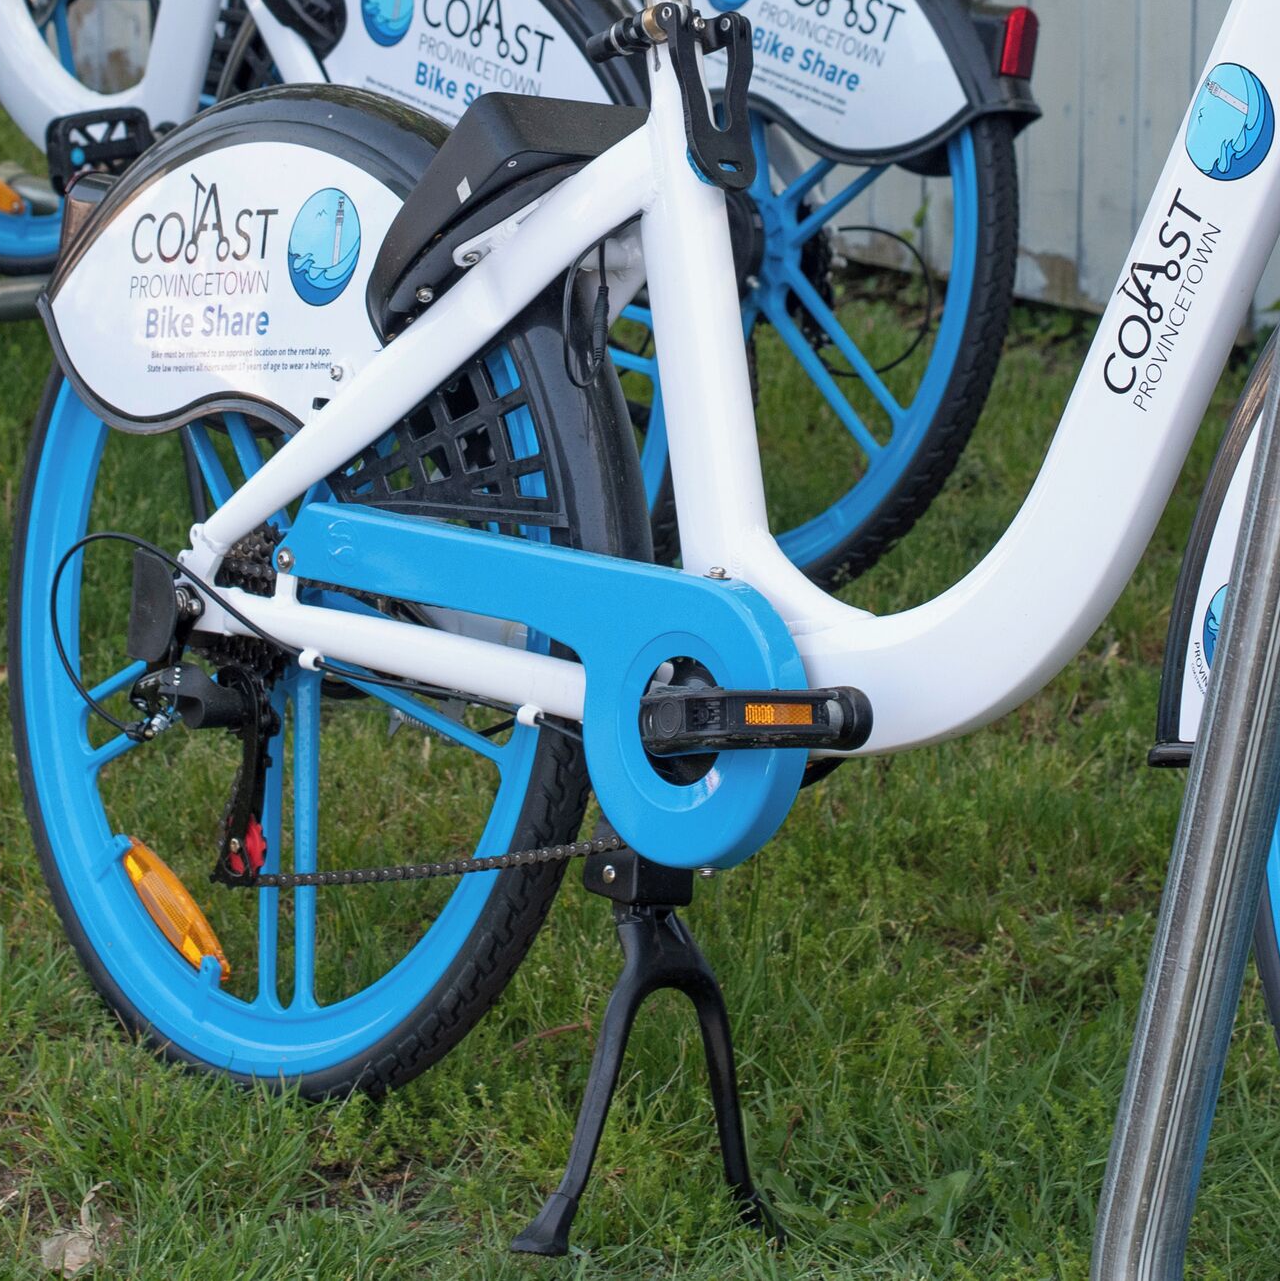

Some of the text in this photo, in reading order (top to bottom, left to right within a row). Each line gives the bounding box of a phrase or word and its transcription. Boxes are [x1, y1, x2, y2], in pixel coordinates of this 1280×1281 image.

[418, 33, 542, 96] PROVINCETOWN
[753, 27, 794, 64] Bike
[799, 48, 860, 92] Share
[758, 1, 886, 68] PROVINCETOWN
[415, 61, 457, 100] Bike
[131, 173, 279, 264] COAST
[129, 270, 270, 299] PROVINCETOWN
[1103, 187, 1203, 396] COAST
[145, 304, 270, 340] Bike Share
[1132, 221, 1222, 412] PROVINCETOWN
[147, 363, 161, 373] State
[162, 363, 172, 372] law
[263, 361, 269, 370] of
[270, 363, 280, 372] age
[282, 362, 288, 370] to
[254, 347, 277, 357] location
[287, 347, 297, 356] the
[298, 346, 317, 355] rental
[318, 347, 332, 357] app.
